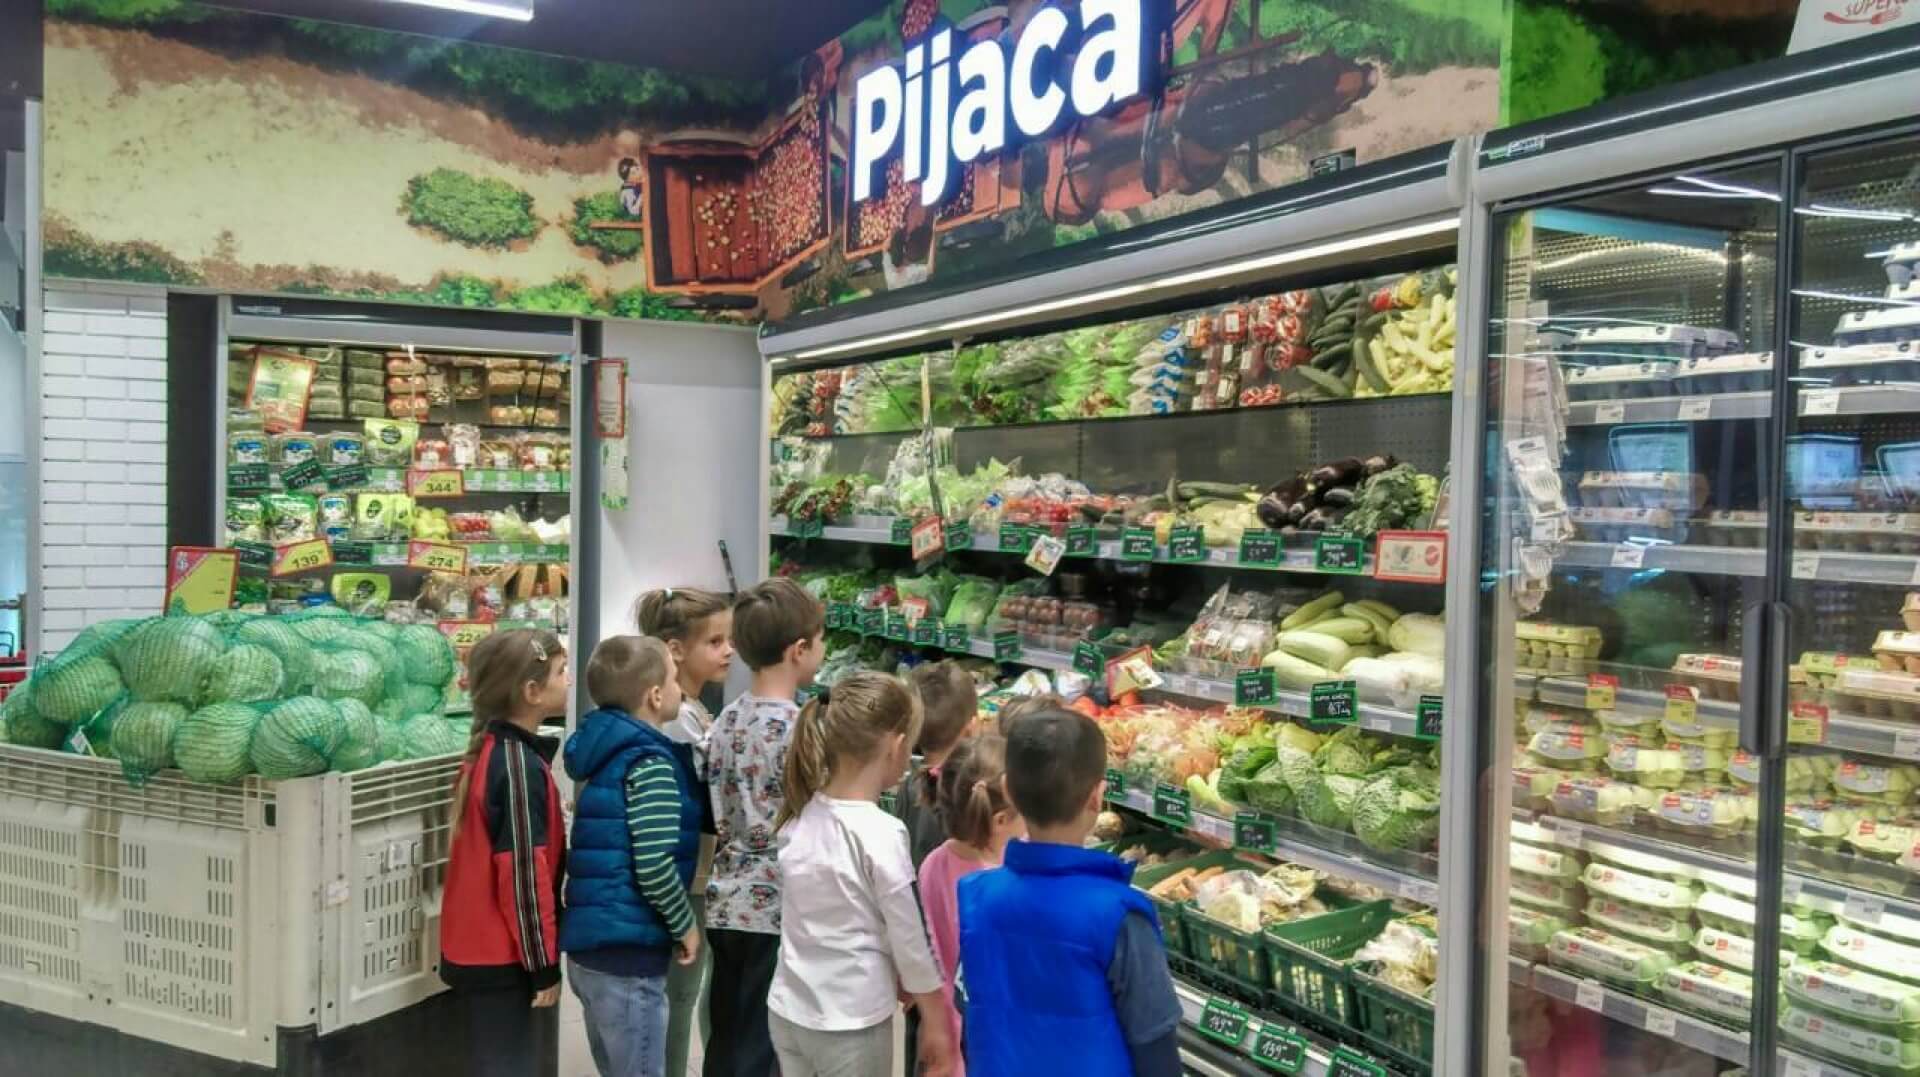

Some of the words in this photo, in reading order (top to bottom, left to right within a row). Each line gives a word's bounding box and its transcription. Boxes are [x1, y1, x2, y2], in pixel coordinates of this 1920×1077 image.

[1844, 0, 1908, 19] SUPE
[853, 0, 1143, 206] Pijaca
[291, 554, 319, 568] 139
[428, 556, 453, 568] 274
